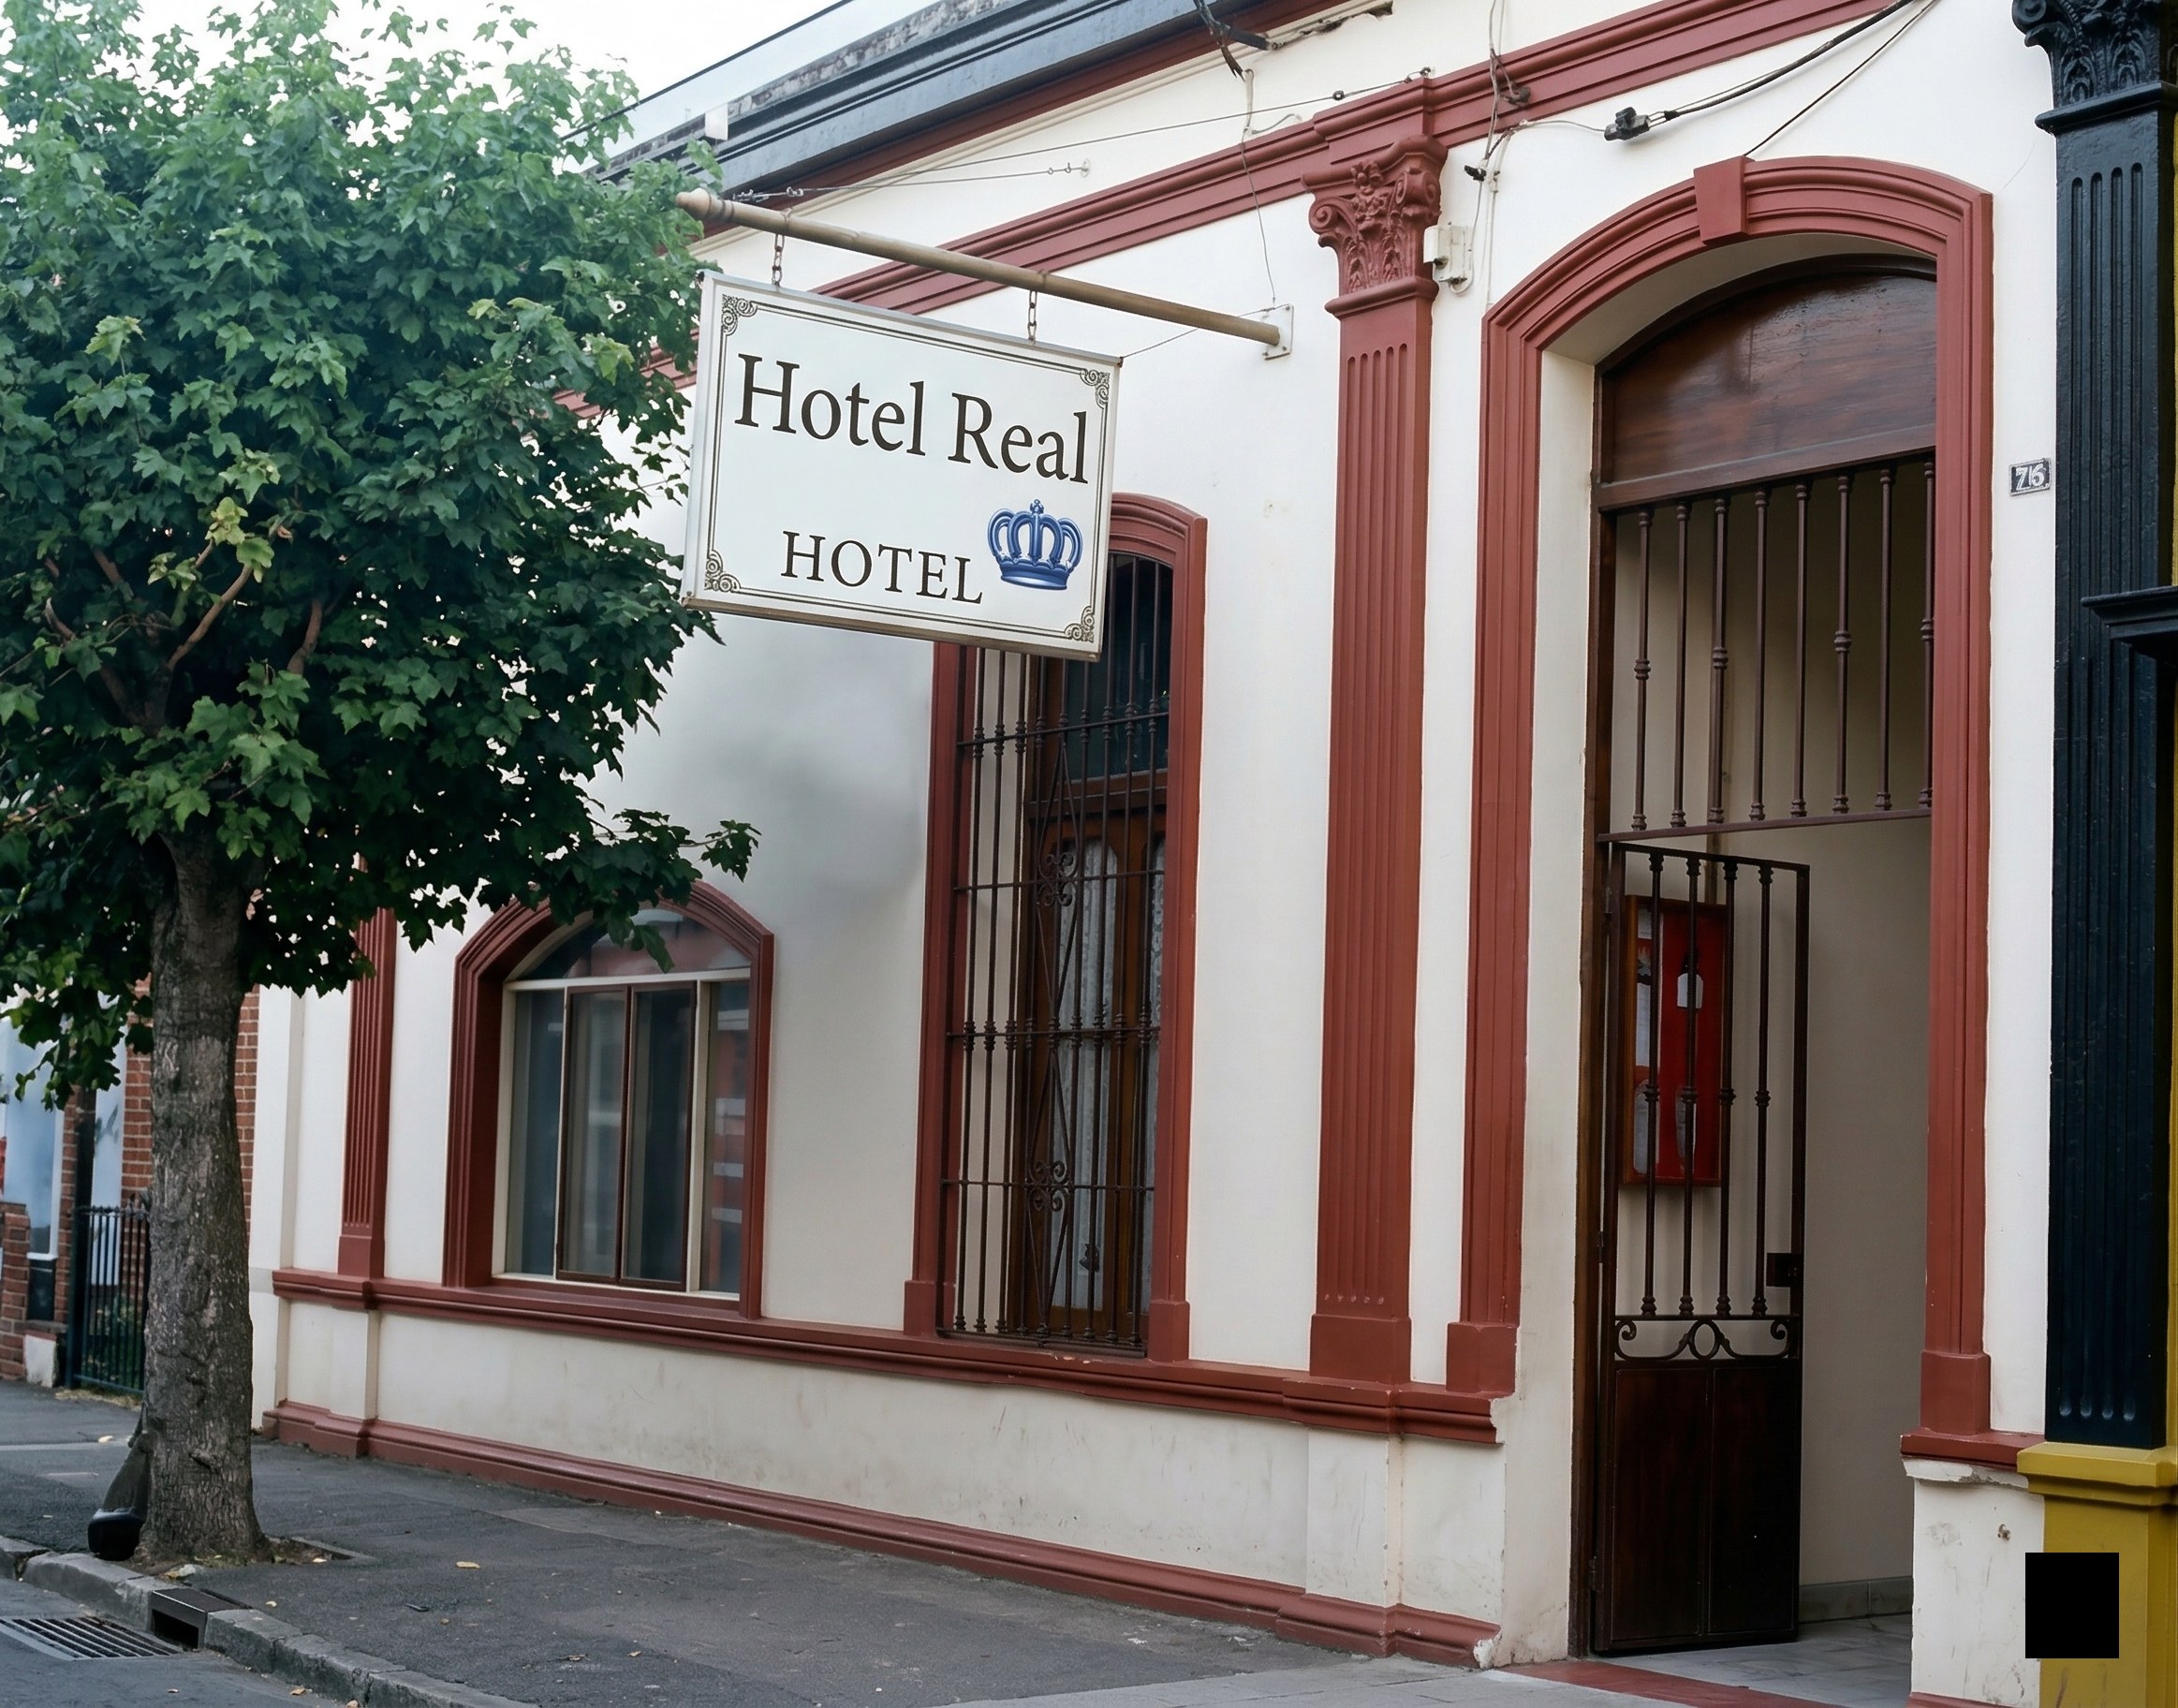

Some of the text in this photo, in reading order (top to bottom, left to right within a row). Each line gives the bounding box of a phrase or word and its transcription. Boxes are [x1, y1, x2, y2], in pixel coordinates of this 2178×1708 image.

[734, 353, 1089, 484] Hotel Real
[780, 530, 983, 605] HOTEL
